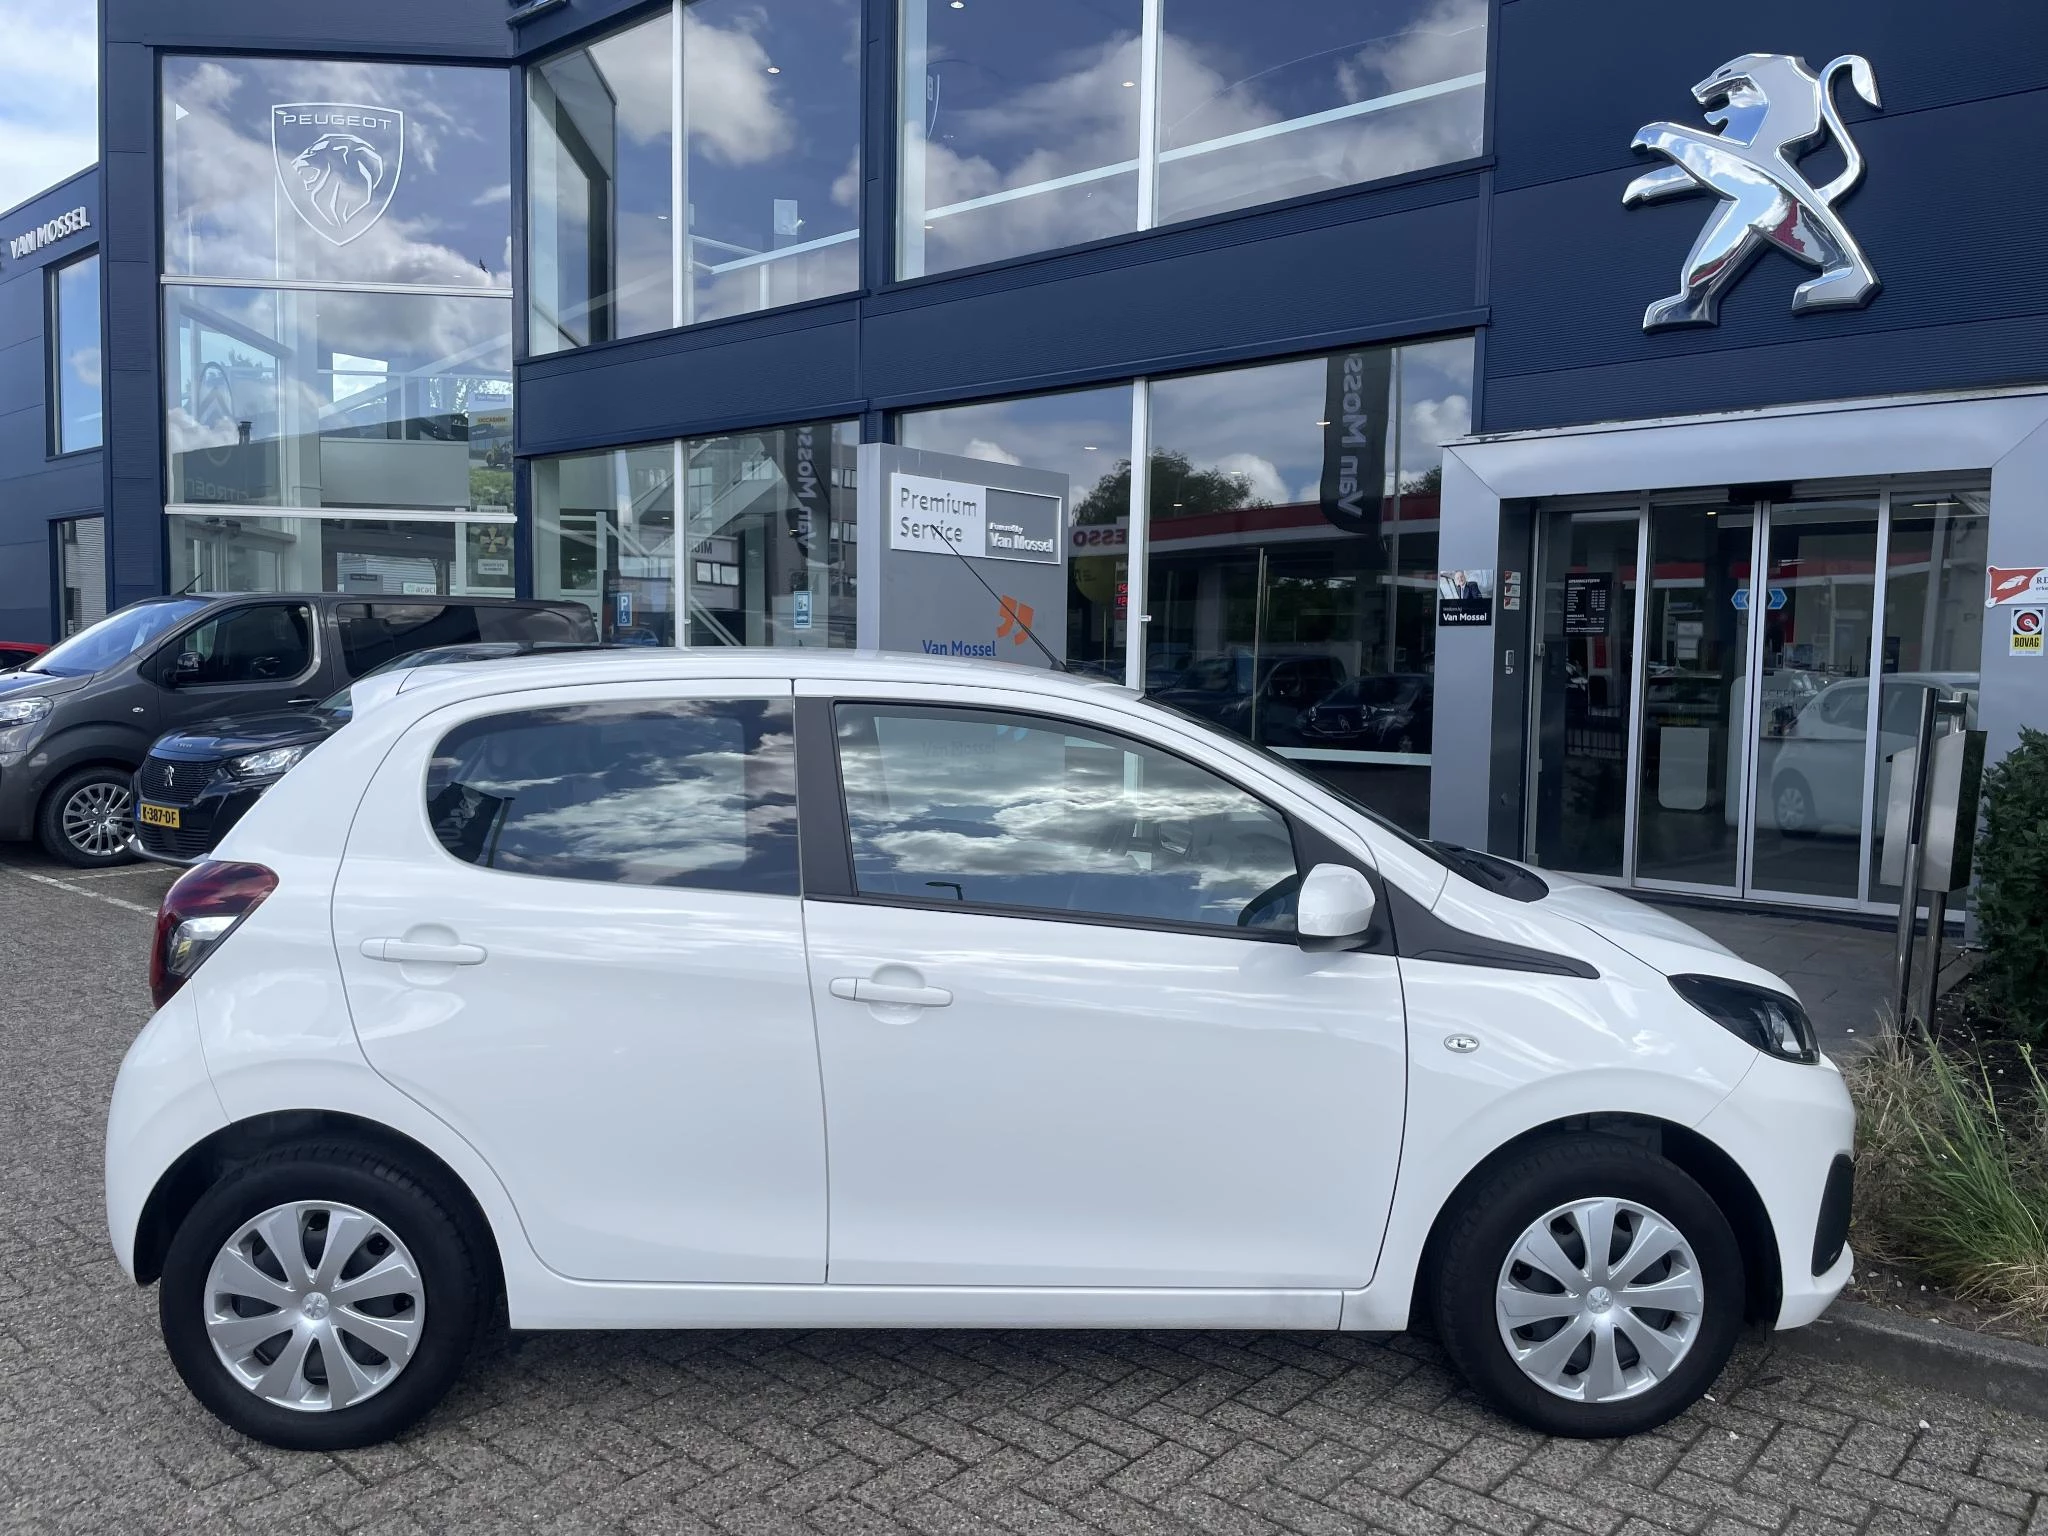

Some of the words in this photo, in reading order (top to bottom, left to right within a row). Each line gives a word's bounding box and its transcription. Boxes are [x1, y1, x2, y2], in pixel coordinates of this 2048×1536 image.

[283, 114, 391, 130] PEUGEOT
[10, 231, 36, 259] VAN
[37, 206, 91, 247] MOSSEL
[901, 487, 977, 517] Premium
[900, 516, 963, 542] Service
[990, 532, 1012, 549] Van
[1013, 534, 1053, 553] Mossel
[1442, 613, 1458, 622] Van
[1459, 612, 1487, 621] Mossel
[922, 639, 948, 655] Van
[951, 640, 997, 657] Mossel
[2014, 637, 2041, 648] BOVAG
[142, 805, 177, 825] K-387-DF
